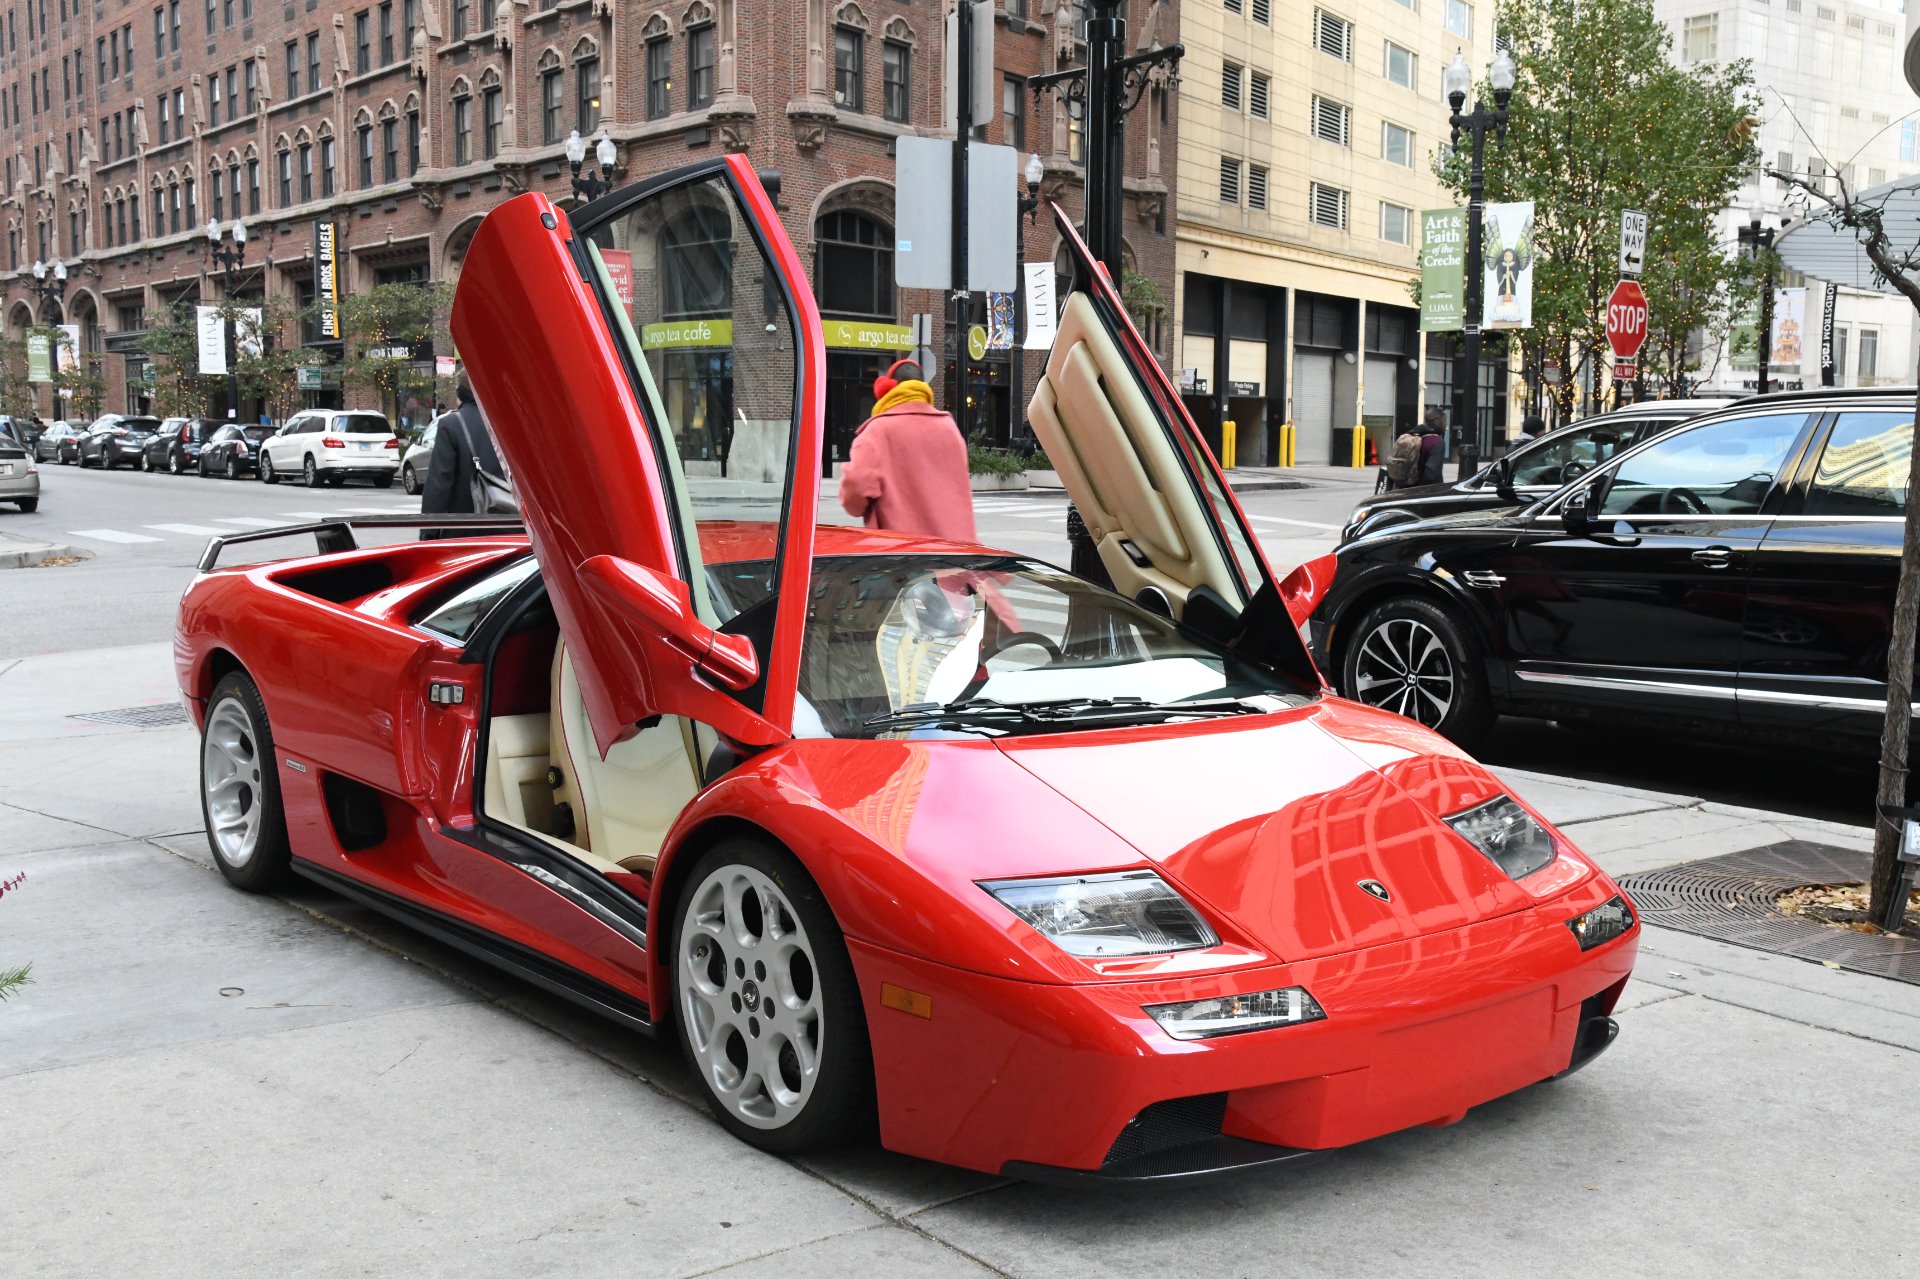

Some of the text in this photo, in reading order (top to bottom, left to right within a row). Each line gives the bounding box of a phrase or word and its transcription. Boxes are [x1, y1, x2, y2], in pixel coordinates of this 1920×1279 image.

[1425, 216, 1461, 230] Art &
[1625, 216, 1644, 233] ONE
[320, 224, 332, 260] BAGELS
[1426, 230, 1460, 244] Faith
[1624, 233, 1643, 249] WAY
[1432, 243, 1454, 255] of the
[1424, 255, 1461, 267] Creche
[321, 263, 333, 289] BROS.
[1034, 269, 1048, 327] LUMA
[1429, 303, 1455, 313] LUMA
[1609, 304, 1646, 335] STOP
[650, 321, 711, 347] argo tea café
[858, 330, 884, 347] argo
[886, 330, 899, 344] tea
[1822, 342, 1832, 368] rack
[1614, 365, 1634, 377] ALL WAY
